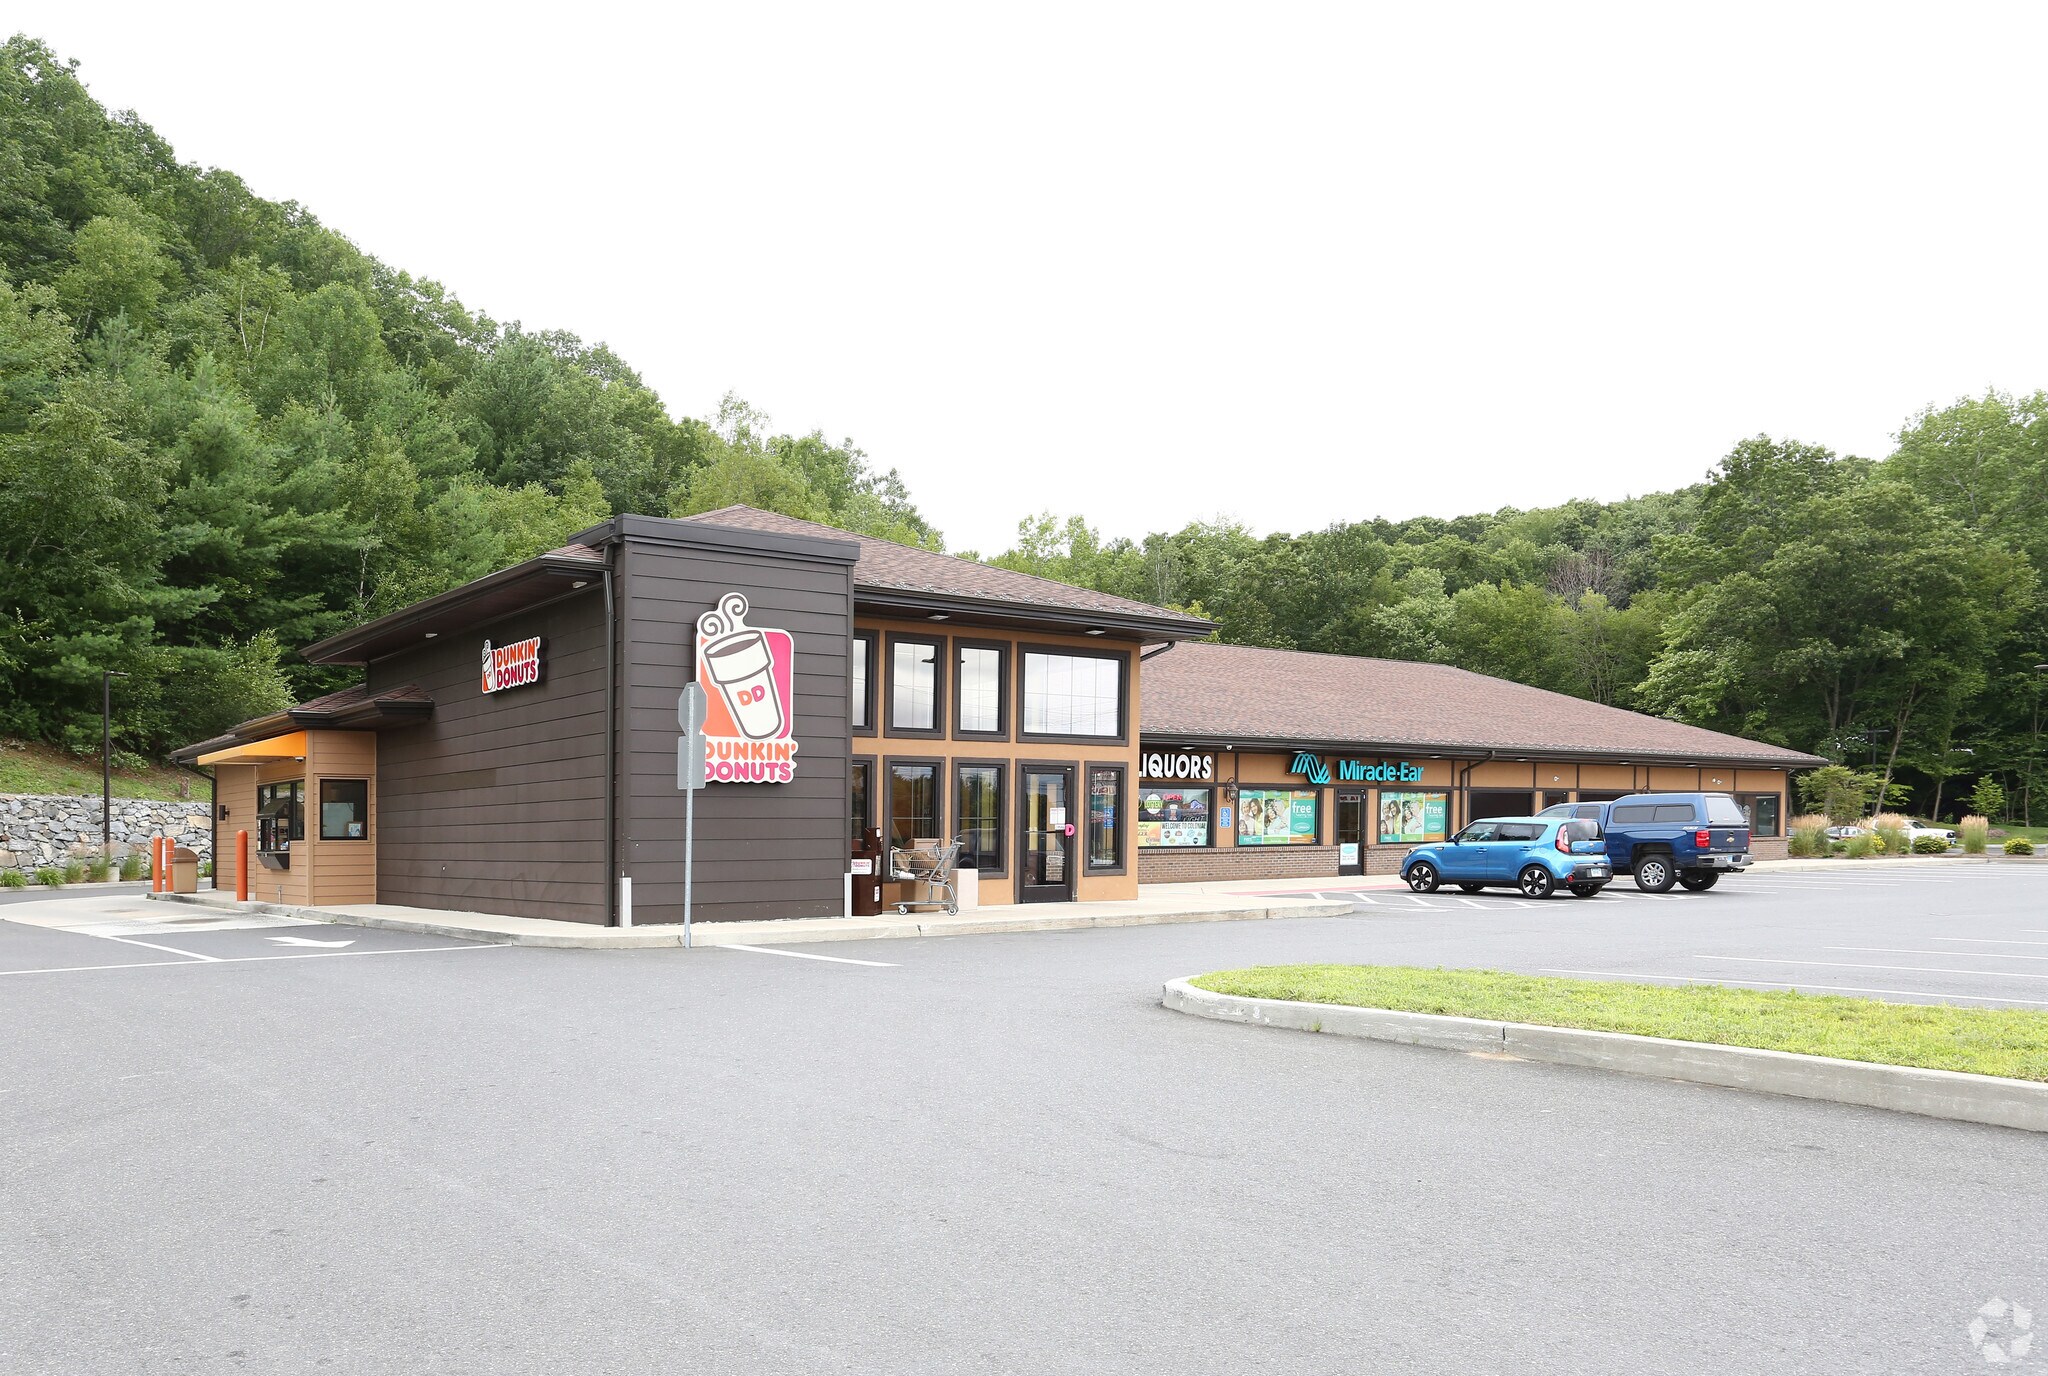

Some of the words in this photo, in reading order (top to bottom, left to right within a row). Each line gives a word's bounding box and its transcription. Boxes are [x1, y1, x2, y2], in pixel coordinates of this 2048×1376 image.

[497, 638, 539, 668] DUNKIN'
[497, 660, 536, 688] DONUTS
[737, 685, 765, 706] DD
[1138, 753, 1212, 779] IQUORS
[1292, 801, 1312, 813] free
[1426, 802, 1443, 814] free
